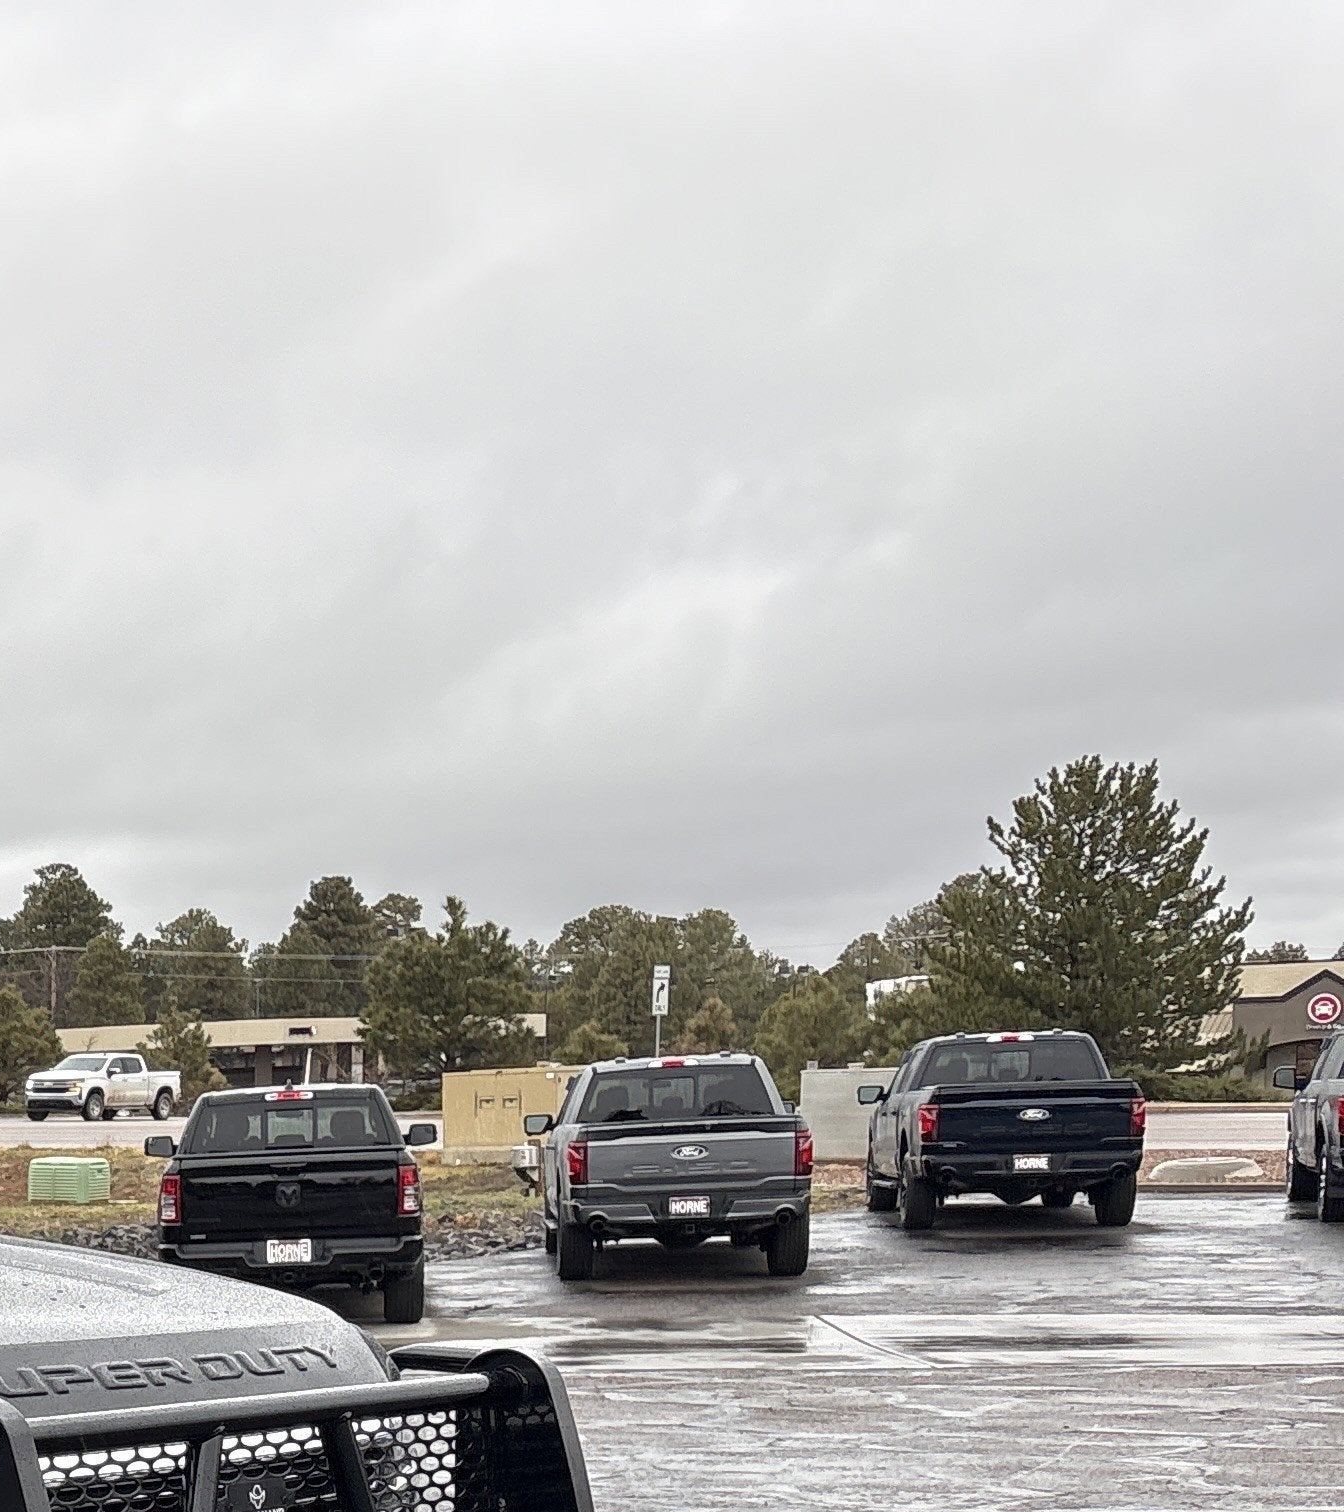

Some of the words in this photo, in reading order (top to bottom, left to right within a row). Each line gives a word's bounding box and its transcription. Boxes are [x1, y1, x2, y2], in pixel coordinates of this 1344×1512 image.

[1014, 1157, 1049, 1170] HORNE
[671, 1200, 708, 1214] HORNE
[270, 1243, 308, 1258] HORNE
[192, 1345, 338, 1381] DUTY
